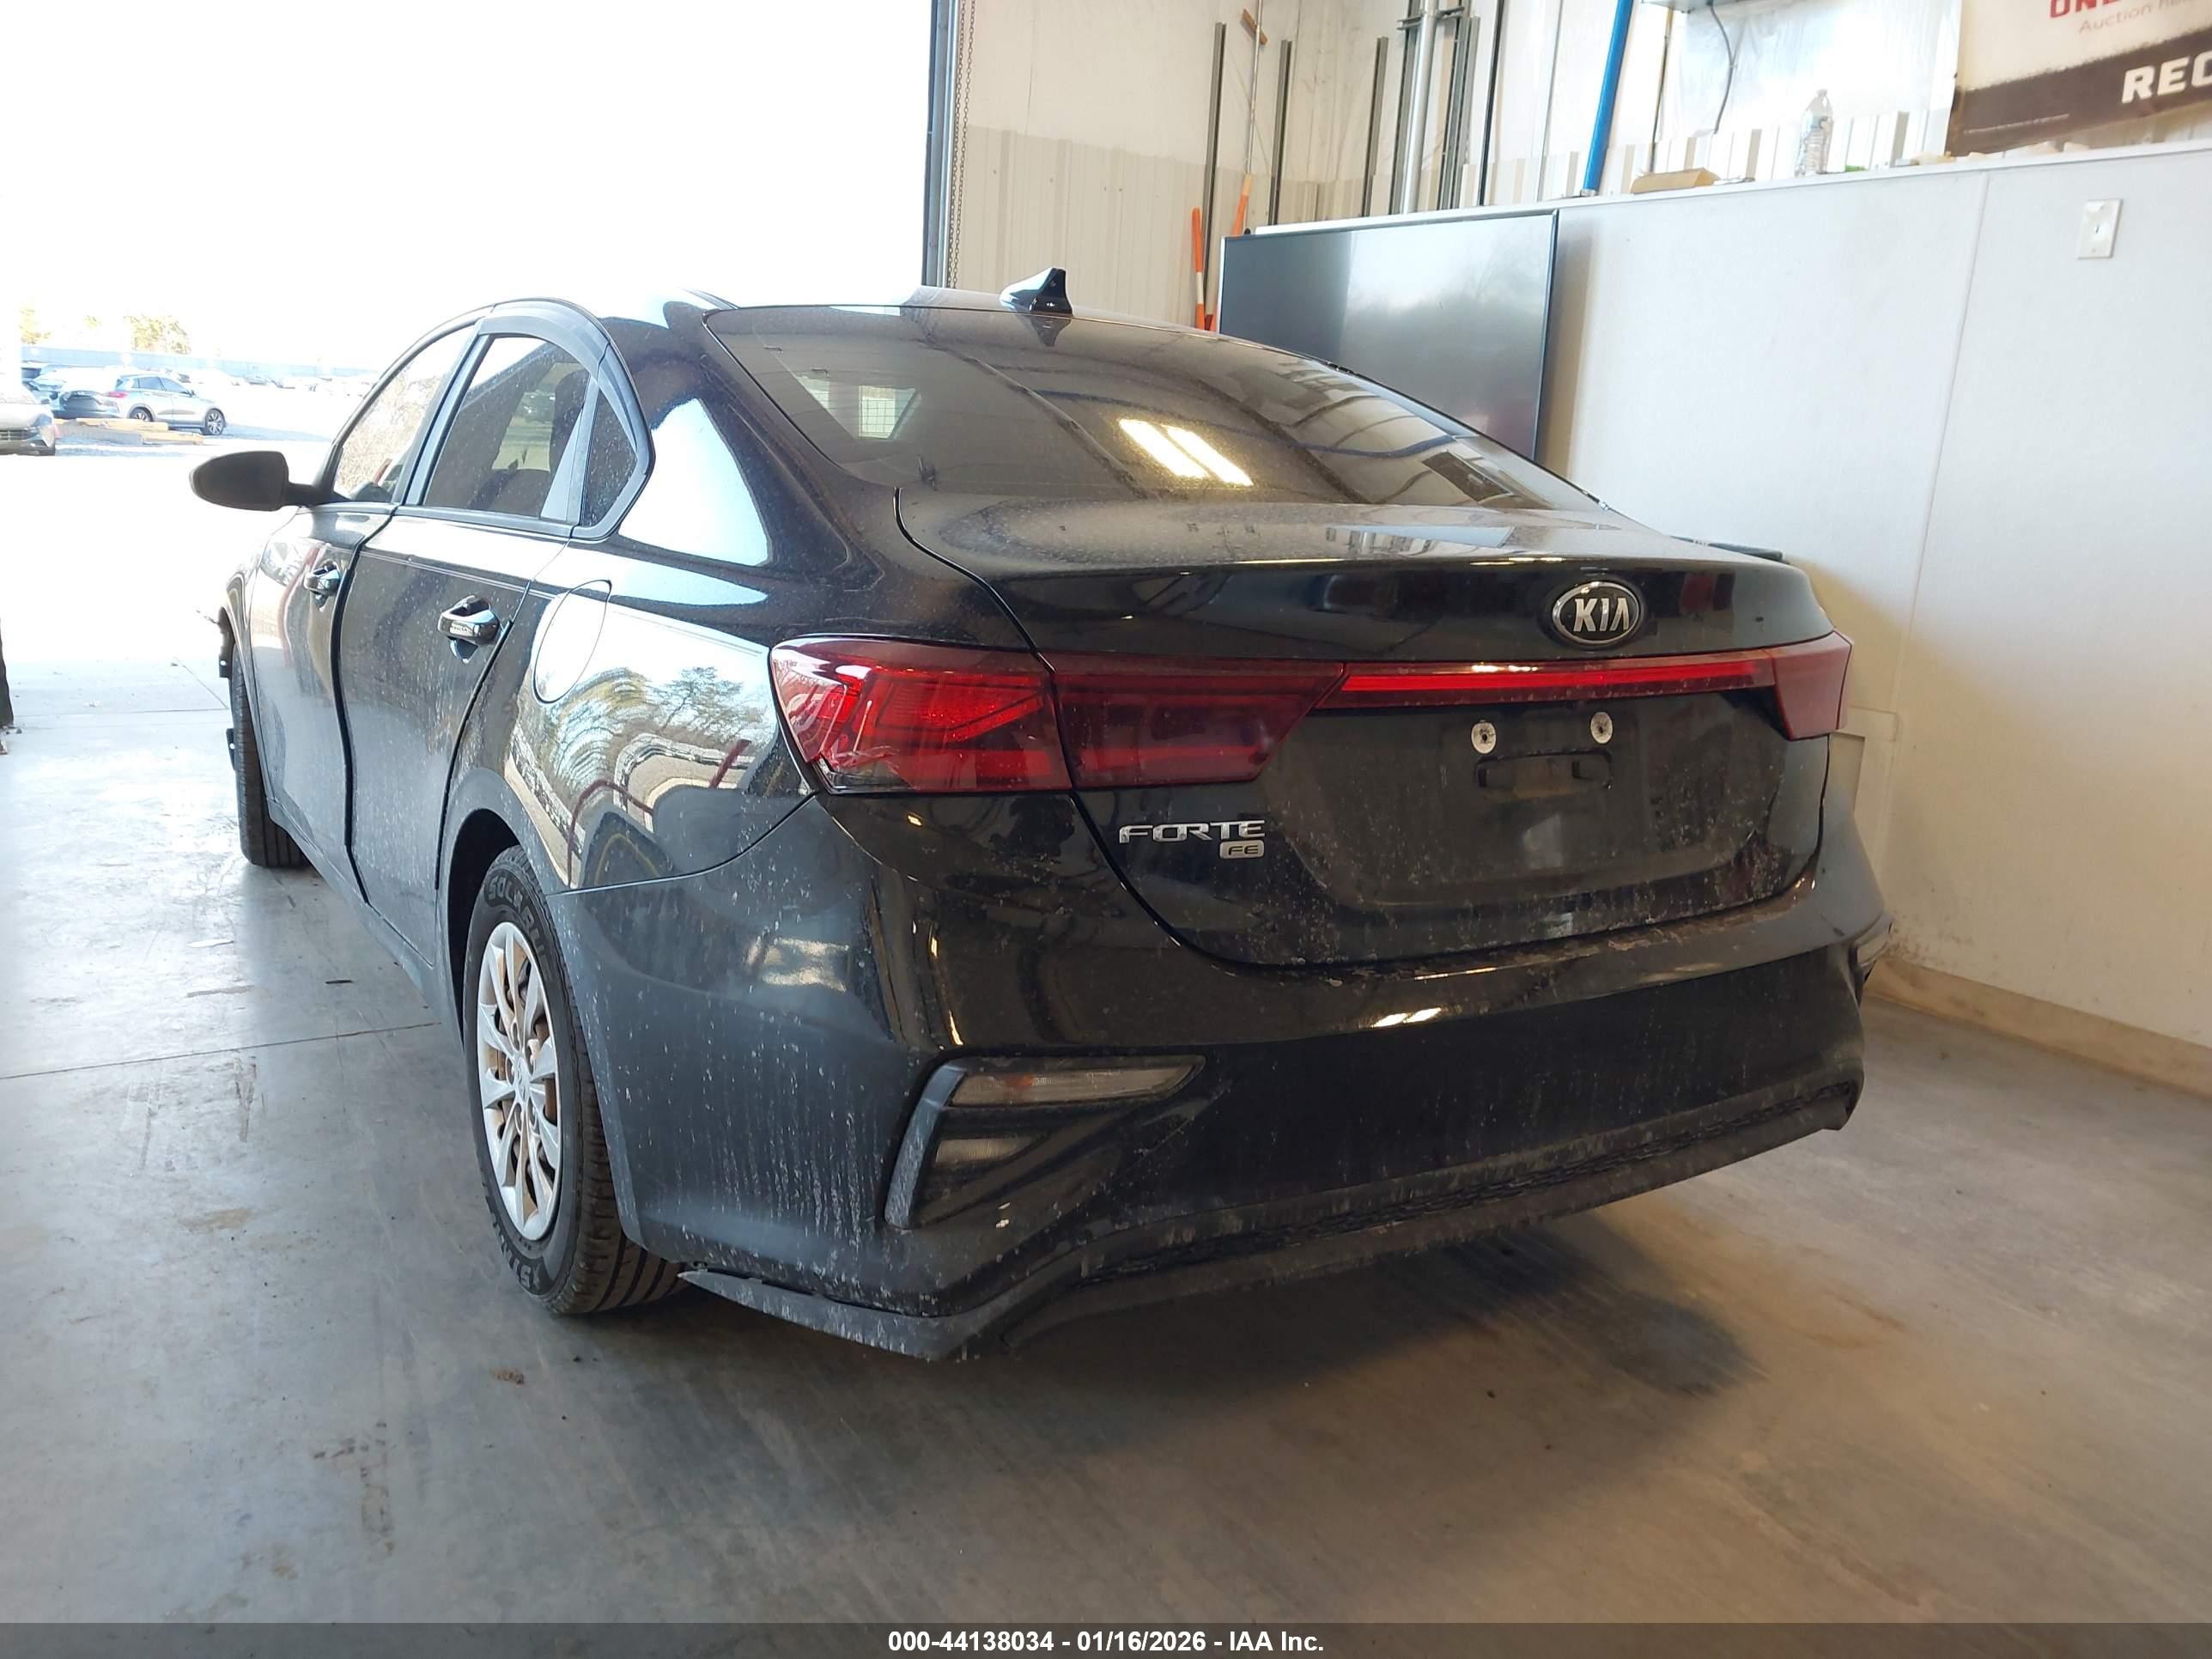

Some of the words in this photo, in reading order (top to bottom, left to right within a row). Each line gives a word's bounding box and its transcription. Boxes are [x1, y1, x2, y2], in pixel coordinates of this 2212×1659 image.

[2078, 3, 2152, 34] Auction
[1573, 597, 1630, 632] KIA
[1119, 820, 1266, 843] FORTE
[1228, 845, 1259, 856] FE
